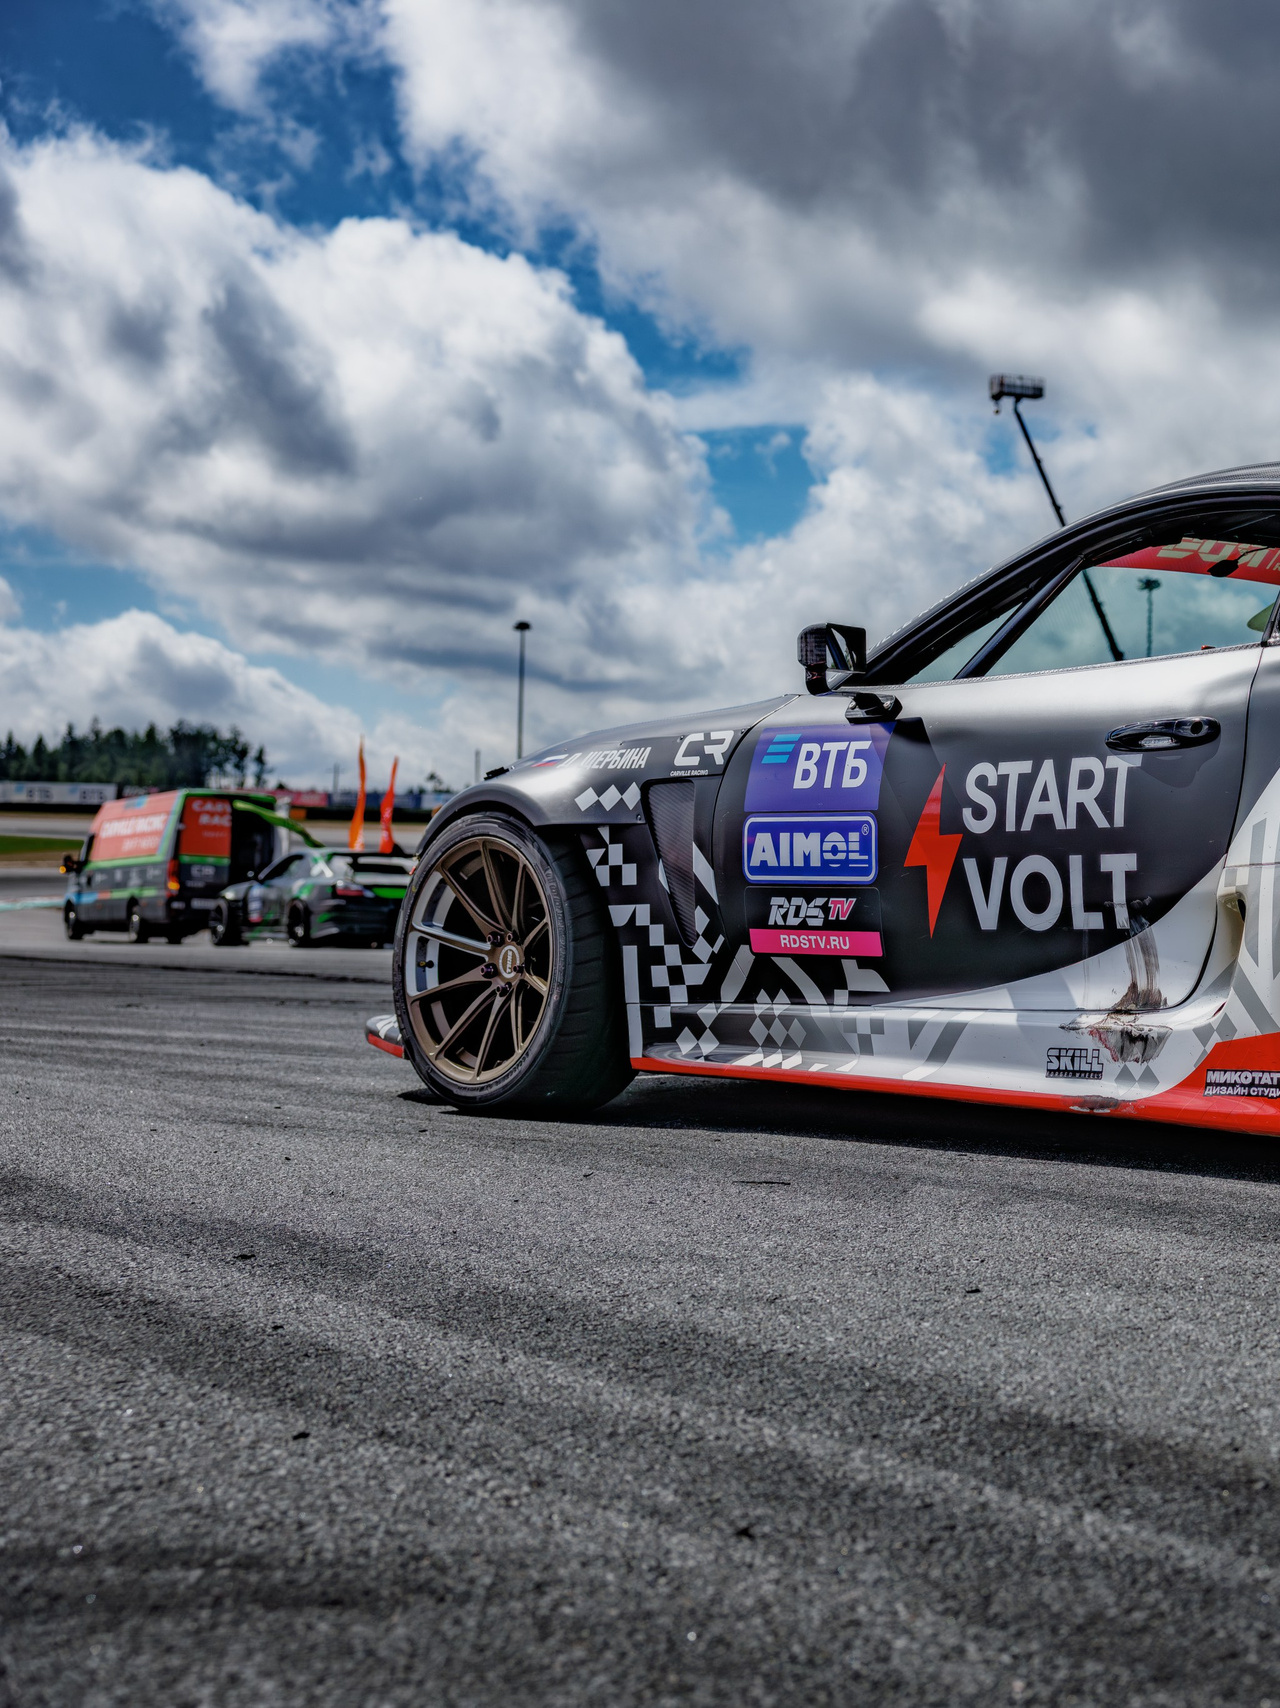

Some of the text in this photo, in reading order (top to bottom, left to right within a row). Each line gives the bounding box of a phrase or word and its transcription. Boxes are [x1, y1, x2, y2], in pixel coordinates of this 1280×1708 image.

[580, 747, 652, 770] ЩЕРБИНА
[674, 730, 735, 767] CR
[793, 740, 872, 789] ВТБ
[962, 754, 1143, 834] START
[962, 853, 1137, 932] VOLT
[780, 935, 850, 950] RDSTV.RU
[1047, 1048, 1104, 1071] SKILL
[1075, 1071, 1102, 1079] WHEELS
[1204, 1084, 1248, 1096] ДИЗАЙН
